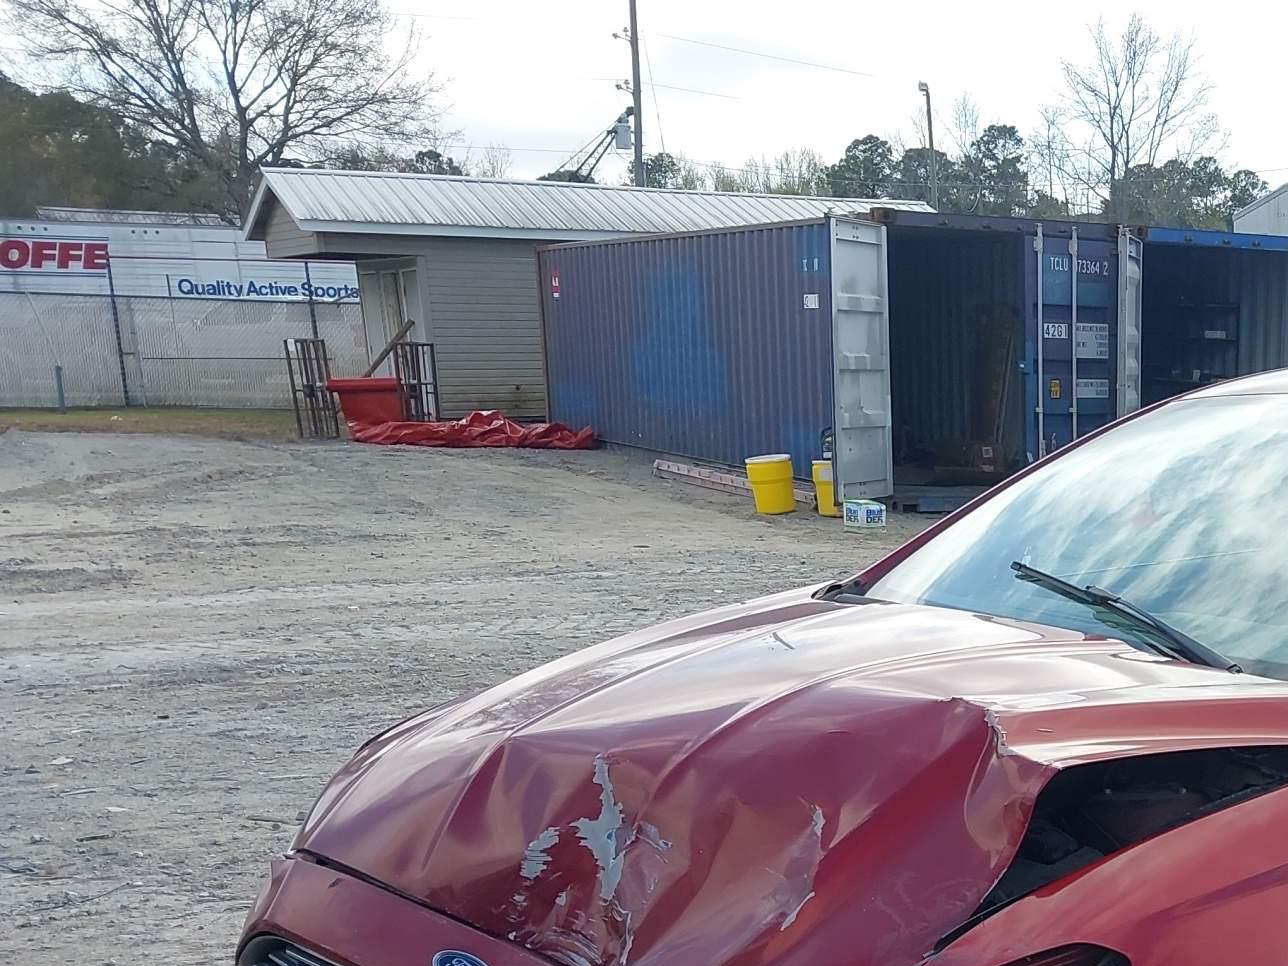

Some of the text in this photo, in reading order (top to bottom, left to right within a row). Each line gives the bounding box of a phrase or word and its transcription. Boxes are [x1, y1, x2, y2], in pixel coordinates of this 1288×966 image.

[1050, 257, 1069, 271] TCLU
[178, 278, 243, 297] Quality
[246, 281, 299, 297] Active
